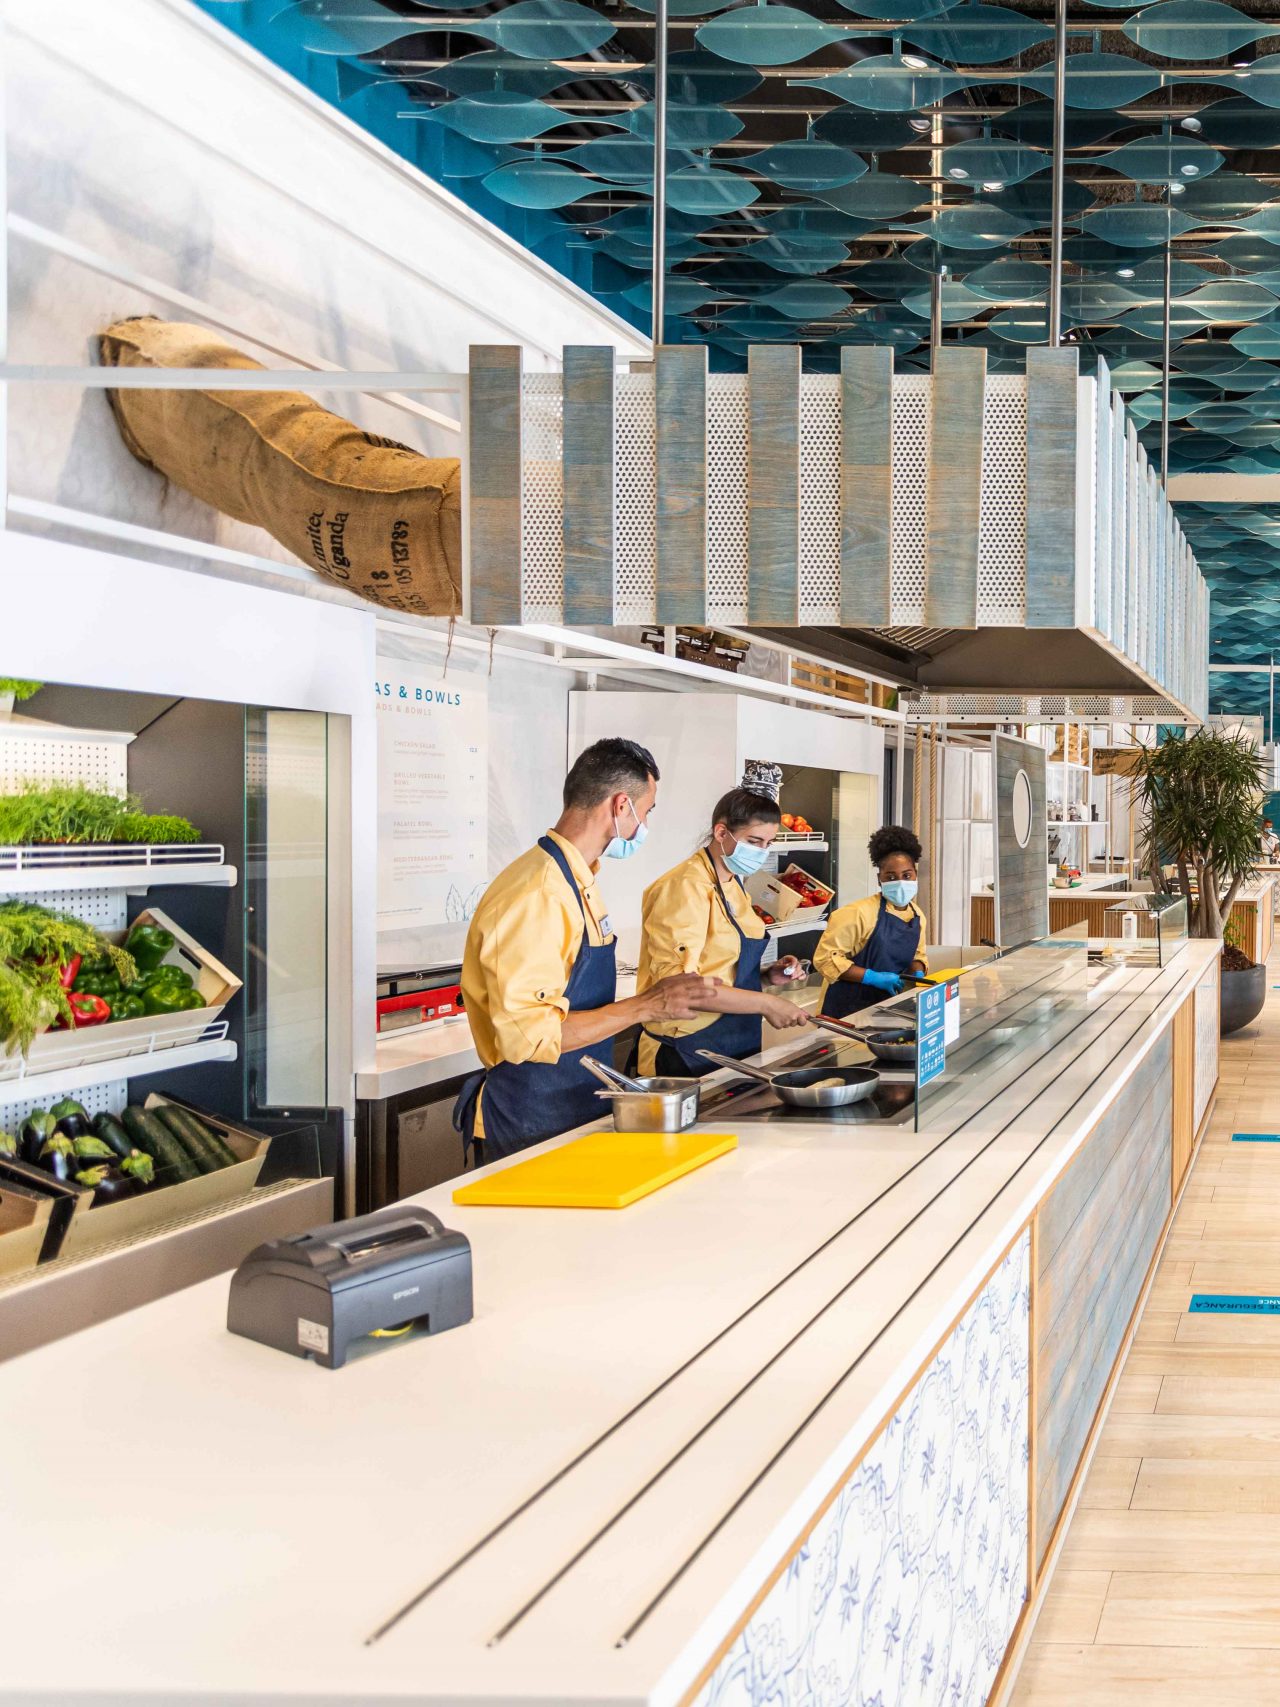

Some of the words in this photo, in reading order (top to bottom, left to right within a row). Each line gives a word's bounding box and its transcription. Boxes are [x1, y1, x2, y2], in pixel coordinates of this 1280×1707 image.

[325, 511, 350, 580] Uganda
[398, 685, 408, 699] &
[415, 688, 461, 706] BOWLS
[405, 706, 432, 717] BOWLS
[392, 1286, 419, 1300] EPSON
[1195, 1302, 1264, 1310] SEGURANÇA
